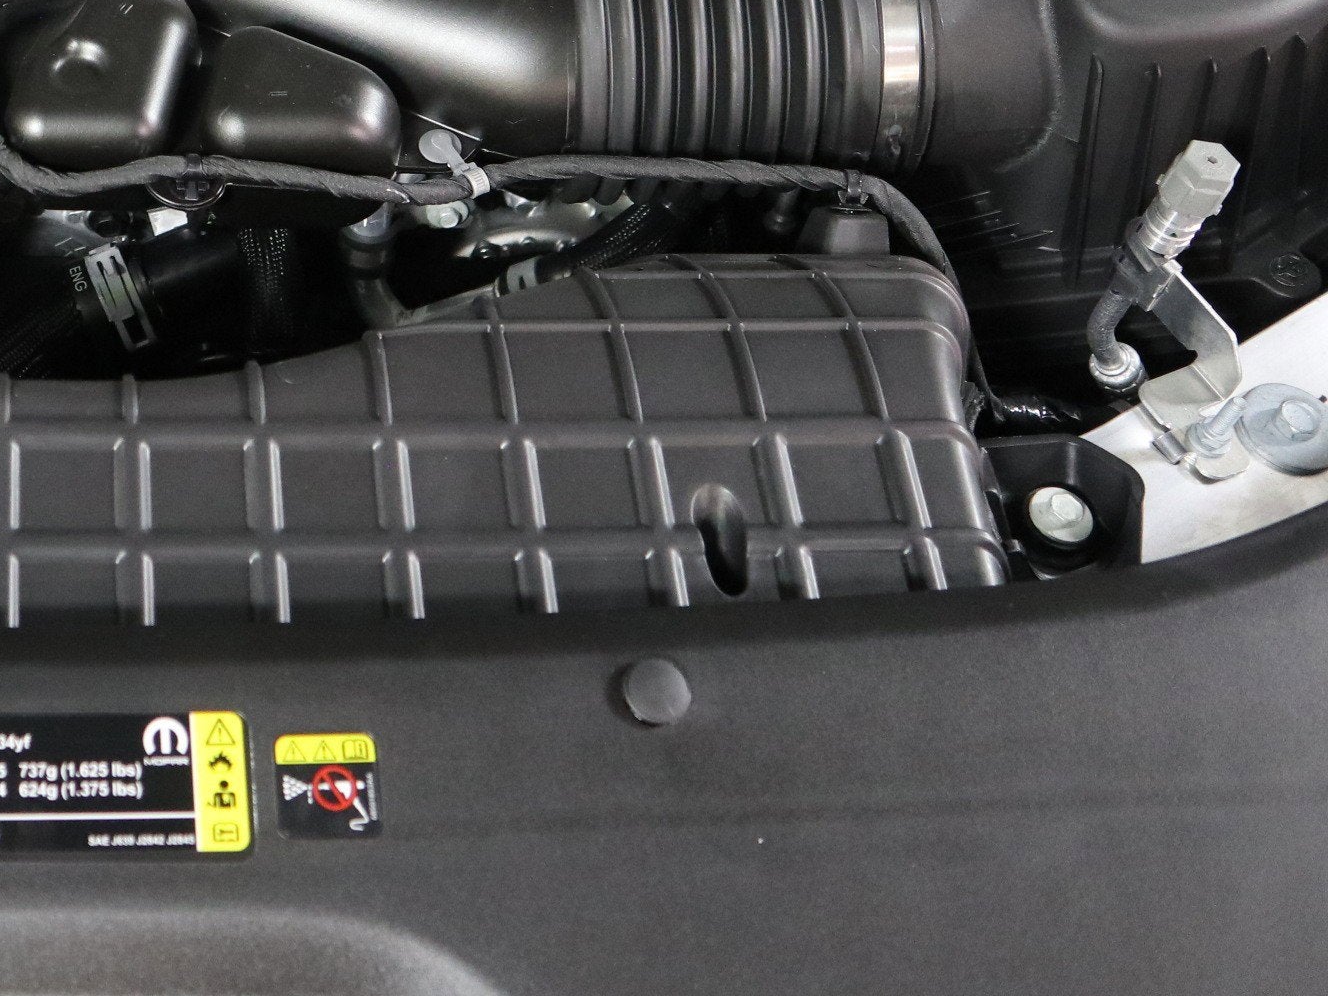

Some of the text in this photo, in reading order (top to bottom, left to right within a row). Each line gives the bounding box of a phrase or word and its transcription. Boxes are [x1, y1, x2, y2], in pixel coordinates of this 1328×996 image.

[69, 265, 88, 292] ENG
[18, 761, 59, 781] 737g
[60, 761, 109, 781] (1.625
[111, 760, 143, 781] lbs)
[142, 756, 190, 767] MOPAR
[18, 781, 59, 801] 624g
[60, 781, 110, 801] (1.375
[111, 781, 144, 800] lbs)
[87, 833, 110, 847] SAE
